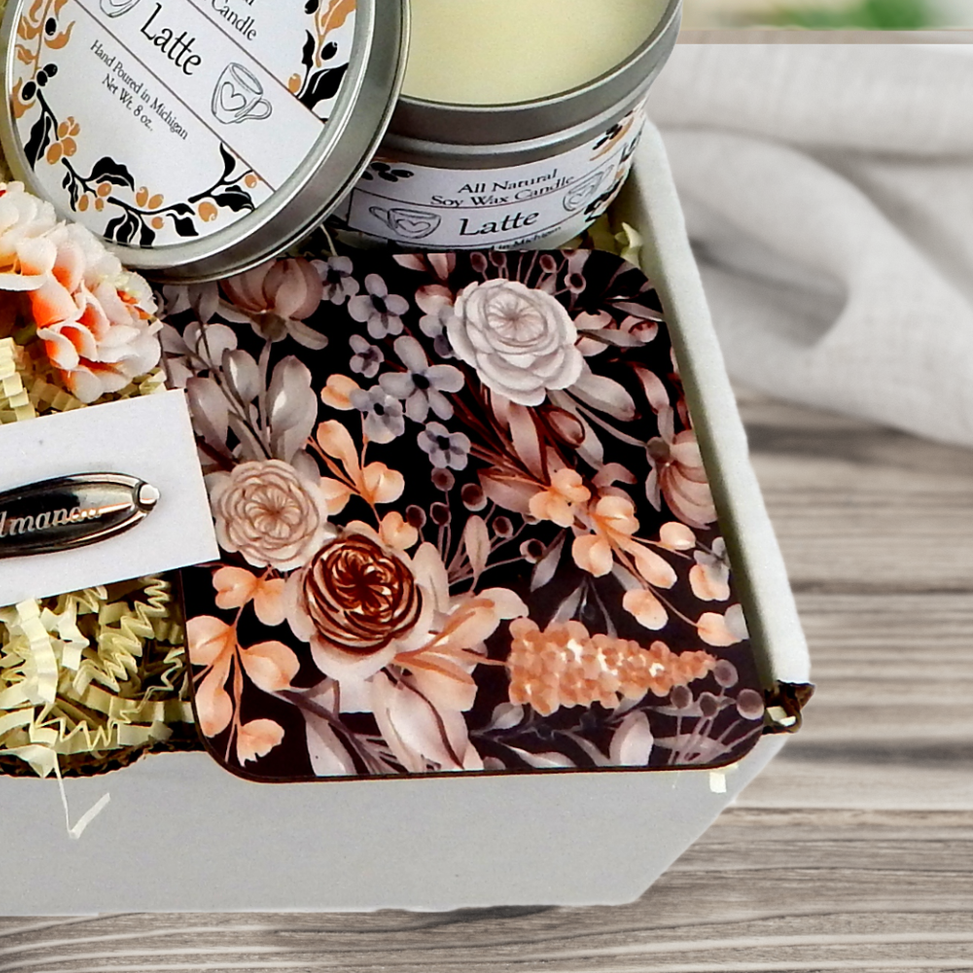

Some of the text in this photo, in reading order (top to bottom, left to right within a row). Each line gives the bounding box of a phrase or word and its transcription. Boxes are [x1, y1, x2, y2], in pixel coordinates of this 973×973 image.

[139, 3, 201, 76] Latte
[90, 39, 188, 140] Hand Poured in Michigan
[102, 73, 153, 132] Net Wt. 8 oz.
[430, 176, 576, 208] Soy Wax Candle
[457, 168, 558, 194] All Natural
[459, 211, 540, 236] Latte
